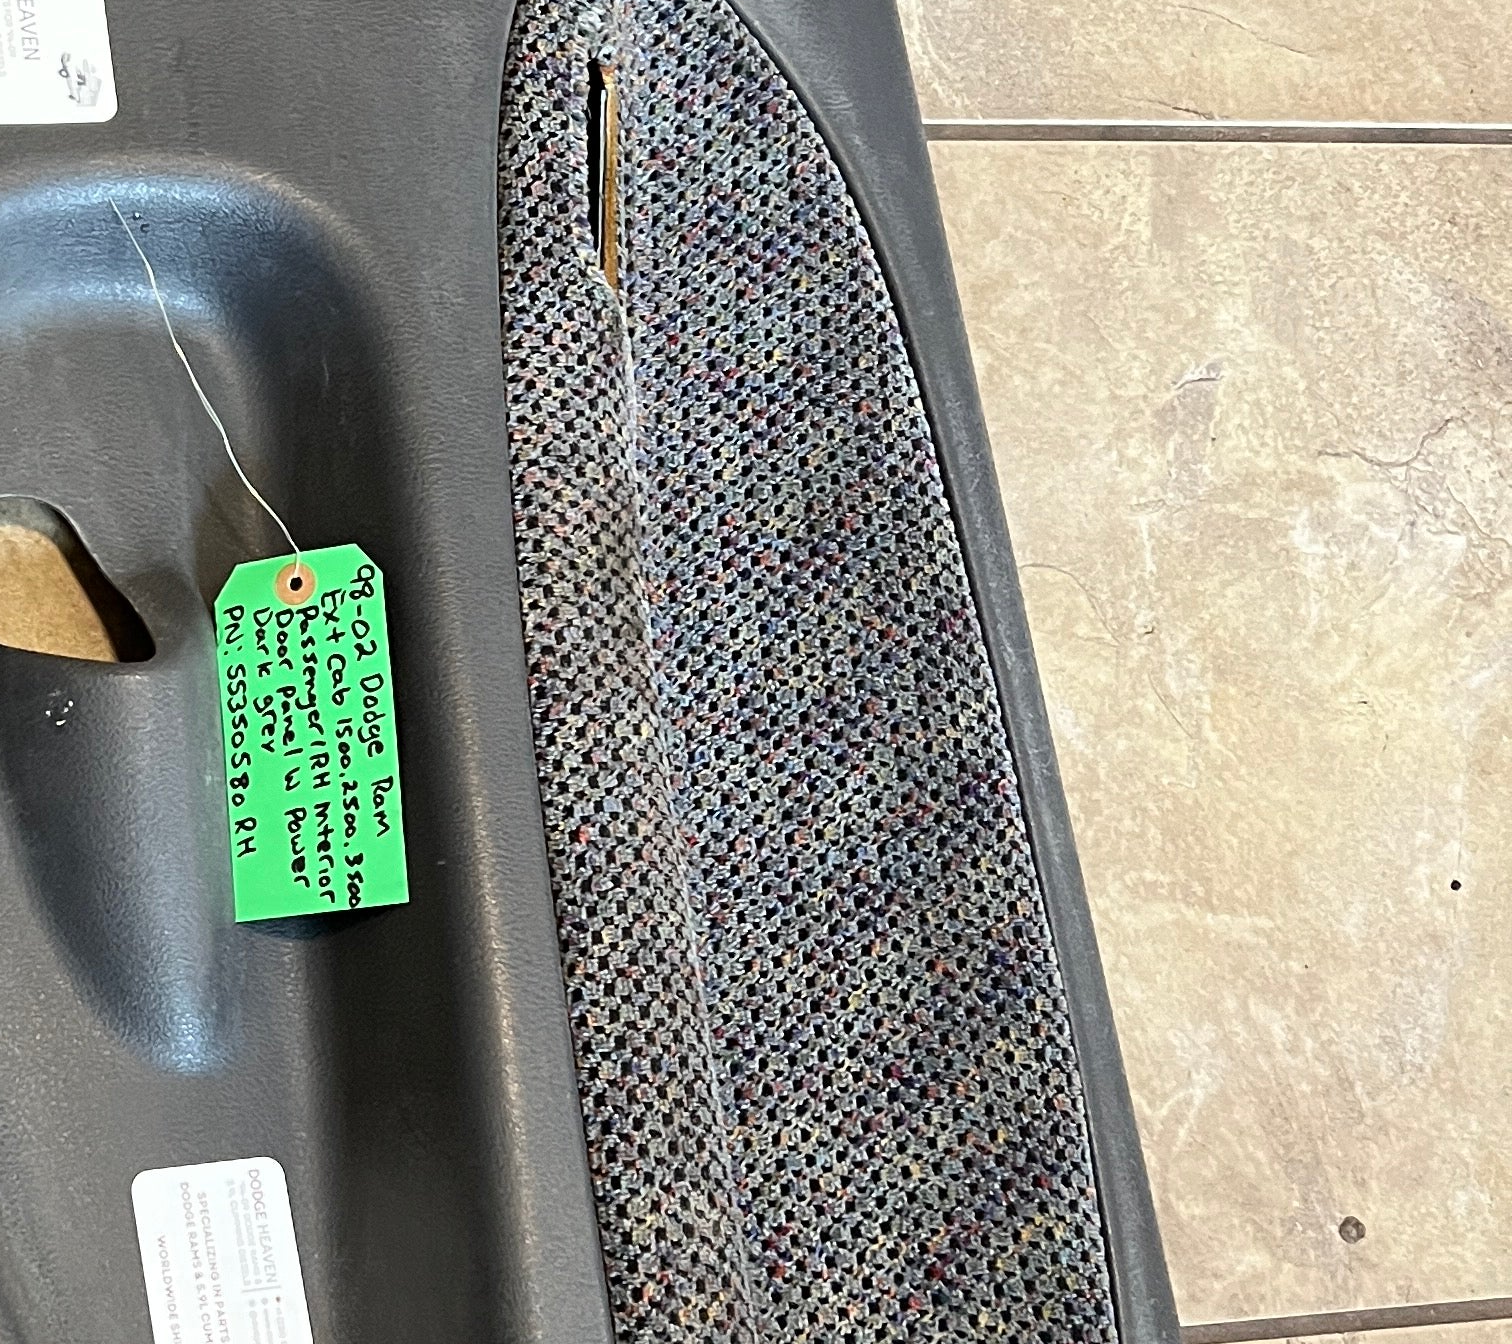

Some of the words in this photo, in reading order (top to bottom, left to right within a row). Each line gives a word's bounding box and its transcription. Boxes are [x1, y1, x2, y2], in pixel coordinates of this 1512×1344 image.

[223, 605, 245, 655] PN:
[253, 606, 274, 677] Dark
[275, 608, 294, 671] Door
[320, 588, 346, 643] Ext
[349, 564, 378, 662] 98-02
[327, 654, 346, 706] Cab
[226, 663, 252, 809] 55350580
[253, 694, 276, 753] grey
[357, 672, 384, 757] Dodge
[235, 816, 257, 858] RH
[372, 774, 393, 837] Ram
[284, 806, 311, 888] Power
[180, 1182, 196, 1229] DODGE
[188, 1231, 201, 1269] RAMS
[248, 1168, 268, 1221] DODGE
[197, 1191, 218, 1282] SPECIALIZING
[257, 1223, 278, 1284] HEAVEN
[157, 1234, 179, 1321] WORLDWIDE
[213, 1284, 223, 1298] IN
[216, 1300, 230, 1344] PARTS
